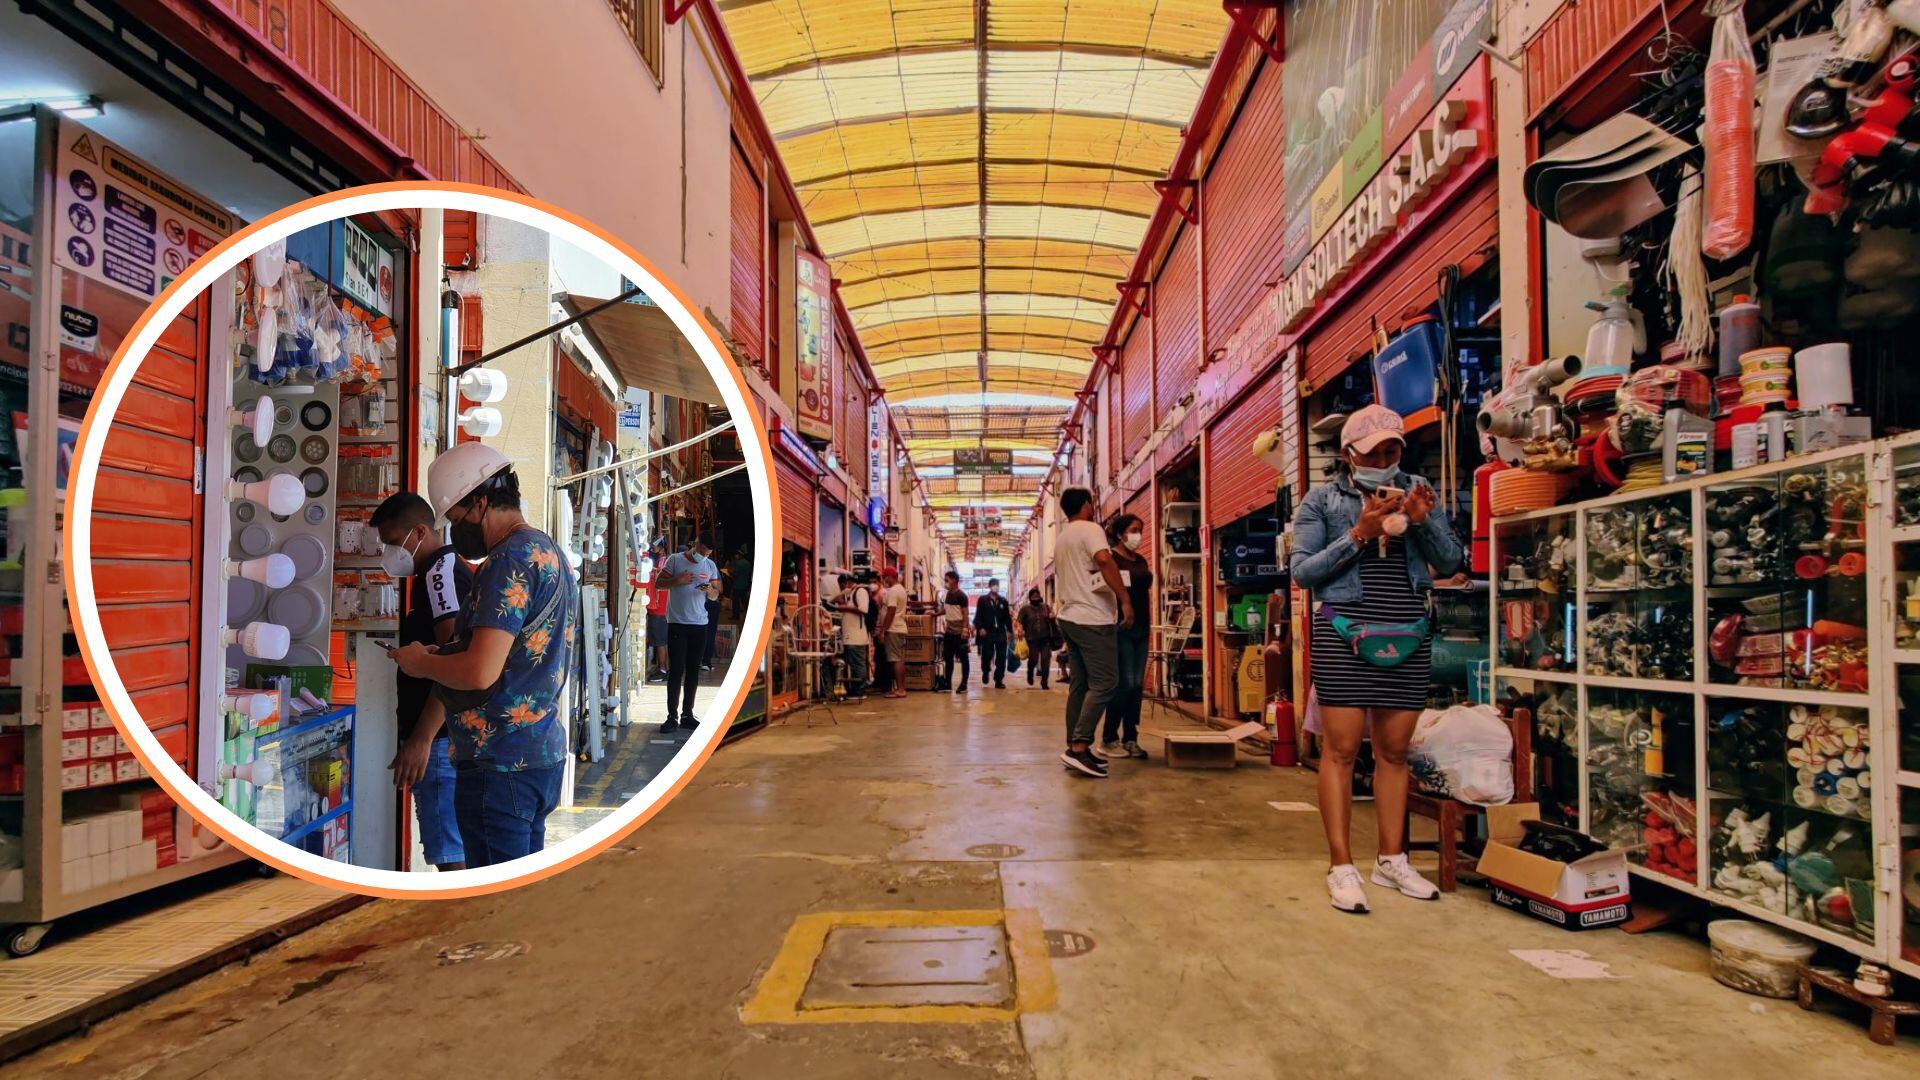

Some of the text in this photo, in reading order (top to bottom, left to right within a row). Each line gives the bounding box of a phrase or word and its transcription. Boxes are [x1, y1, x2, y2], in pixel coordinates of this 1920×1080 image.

[1306, 175, 1383, 299] SOLTECH
[1388, 99, 1478, 214] S.A.C.
[820, 295, 831, 421] REPUESTOS
[1531, 901, 1564, 921] YAMAMOTO
[1583, 907, 1626, 923] YAMAMOTO
